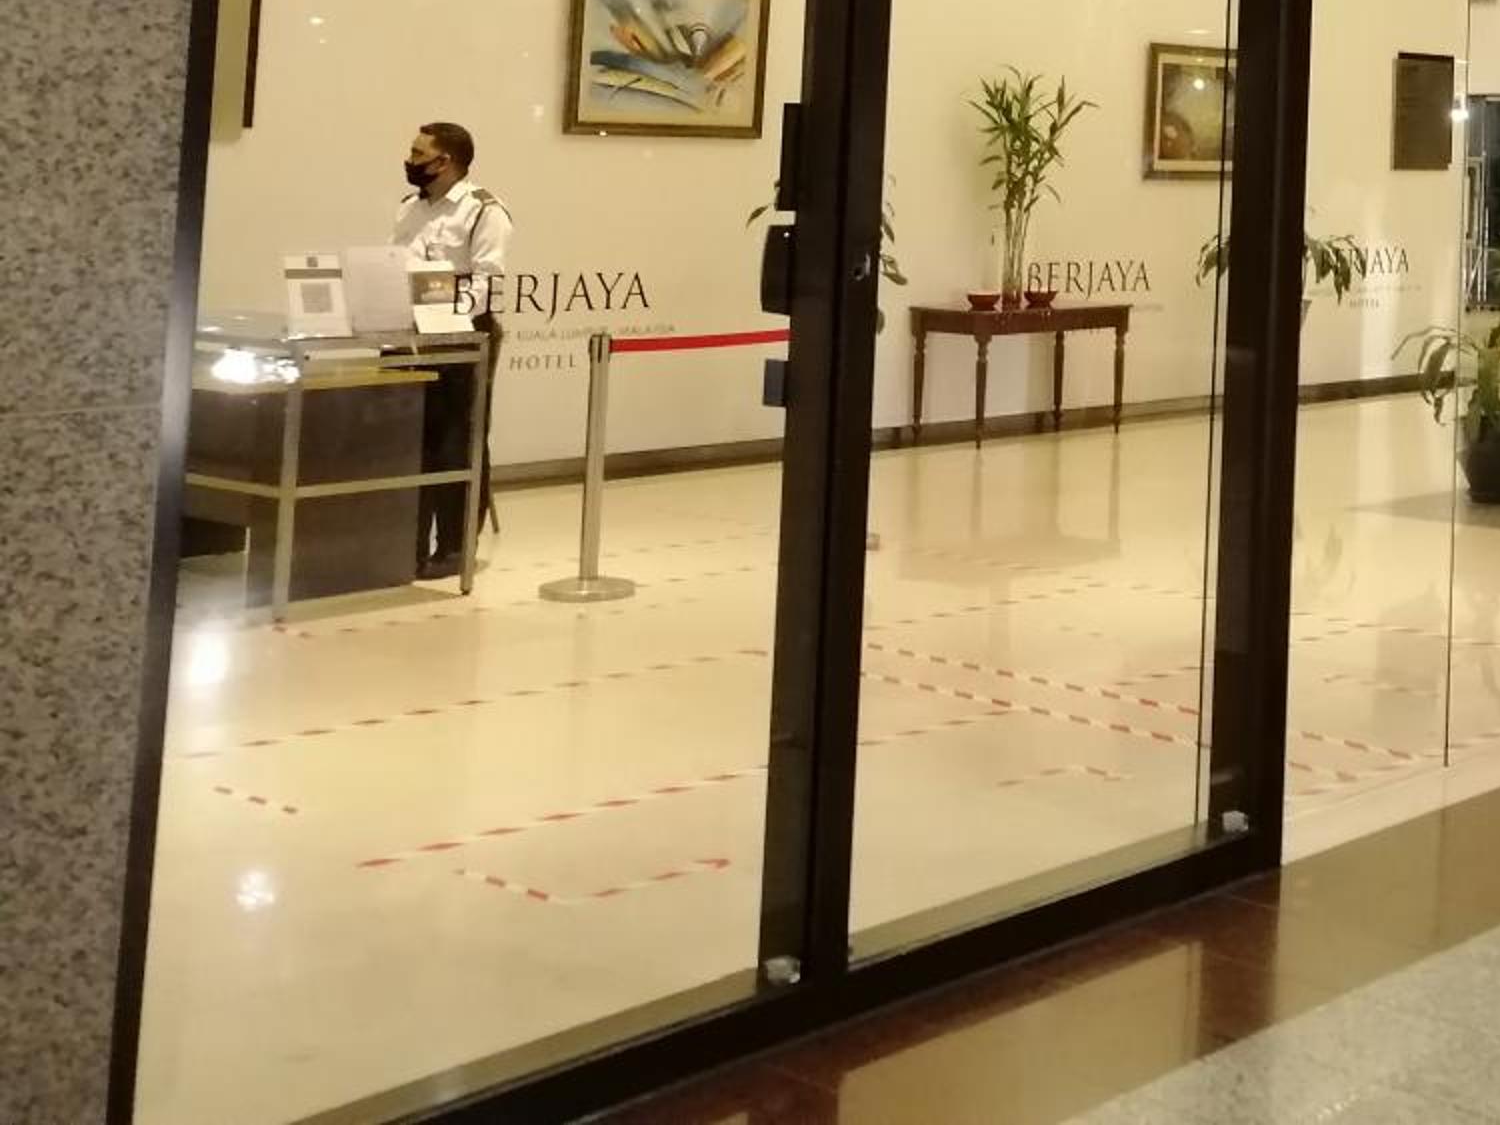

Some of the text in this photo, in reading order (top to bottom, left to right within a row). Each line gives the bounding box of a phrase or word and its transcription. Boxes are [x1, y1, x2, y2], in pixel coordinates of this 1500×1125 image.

[453, 272, 650, 322] BERJAYA
[1028, 261, 1150, 299] BERJAYA
[509, 354, 577, 370] HOTEL
